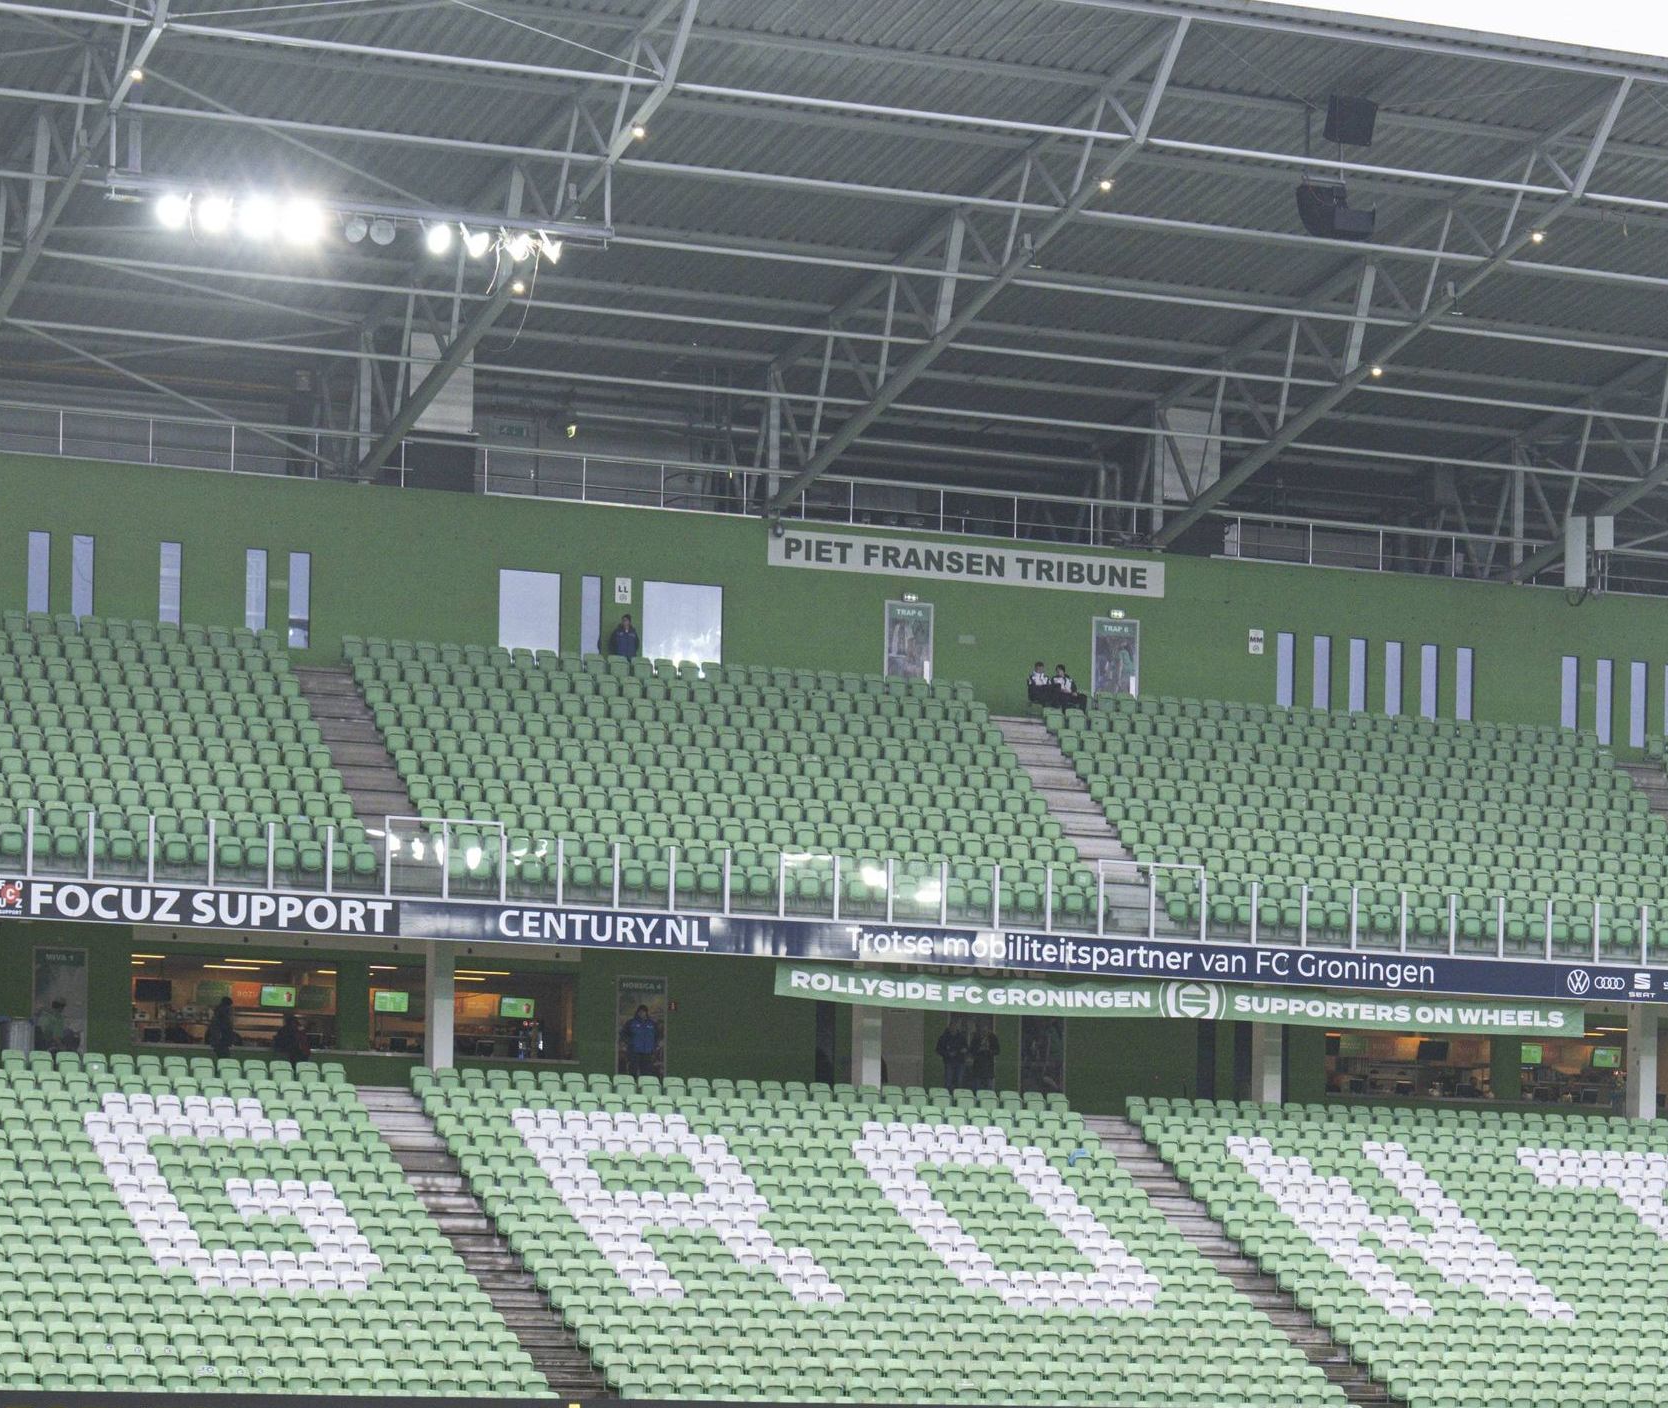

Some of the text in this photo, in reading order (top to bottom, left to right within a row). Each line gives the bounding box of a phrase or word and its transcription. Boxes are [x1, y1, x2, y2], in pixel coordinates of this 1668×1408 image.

[784, 537, 1148, 590] PIET FRANSEN TRIBUNE
[896, 608, 916, 617] TRAP
[1103, 625, 1122, 633] TRAP
[30, 883, 392, 932] FOCUZ SUPPORT
[498, 910, 709, 947] CENTURY.NL
[845, 927, 1434, 988] Trotse mobiliteitspartner van FC Groningen
[791, 970, 942, 1001] ROLLYSIDE
[947, 985, 984, 1004] FC
[987, 988, 1151, 1009] GRONINGEN
[1234, 995, 1565, 1028] SUPPORTERS ON WHEELS
